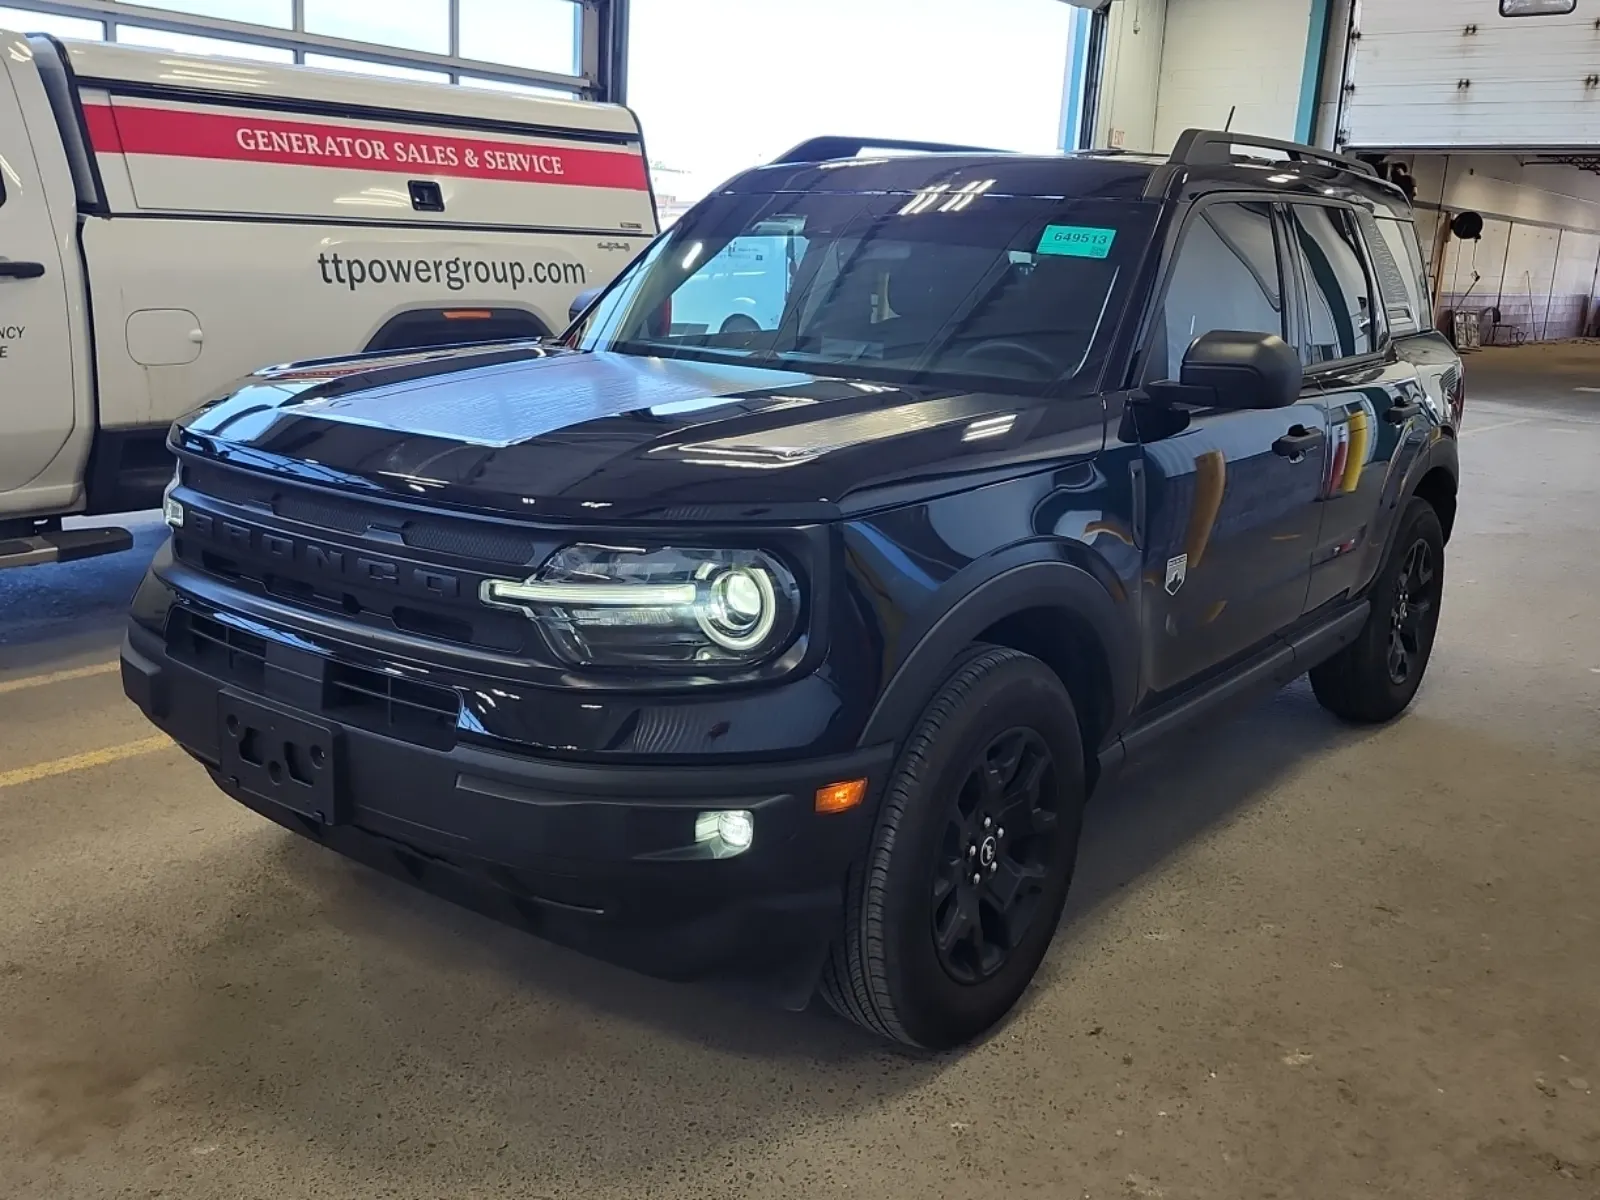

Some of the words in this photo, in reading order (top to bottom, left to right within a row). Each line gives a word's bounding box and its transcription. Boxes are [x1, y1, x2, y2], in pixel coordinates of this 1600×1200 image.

[236, 128, 389, 161] GENERATOR
[393, 141, 459, 167] SALES
[464, 148, 480, 168] &
[483, 149, 564, 175] SERVICE
[1054, 232, 1108, 245] 649513
[318, 252, 587, 291] ttpowergroup.com
[188, 509, 461, 598] BRONCO
